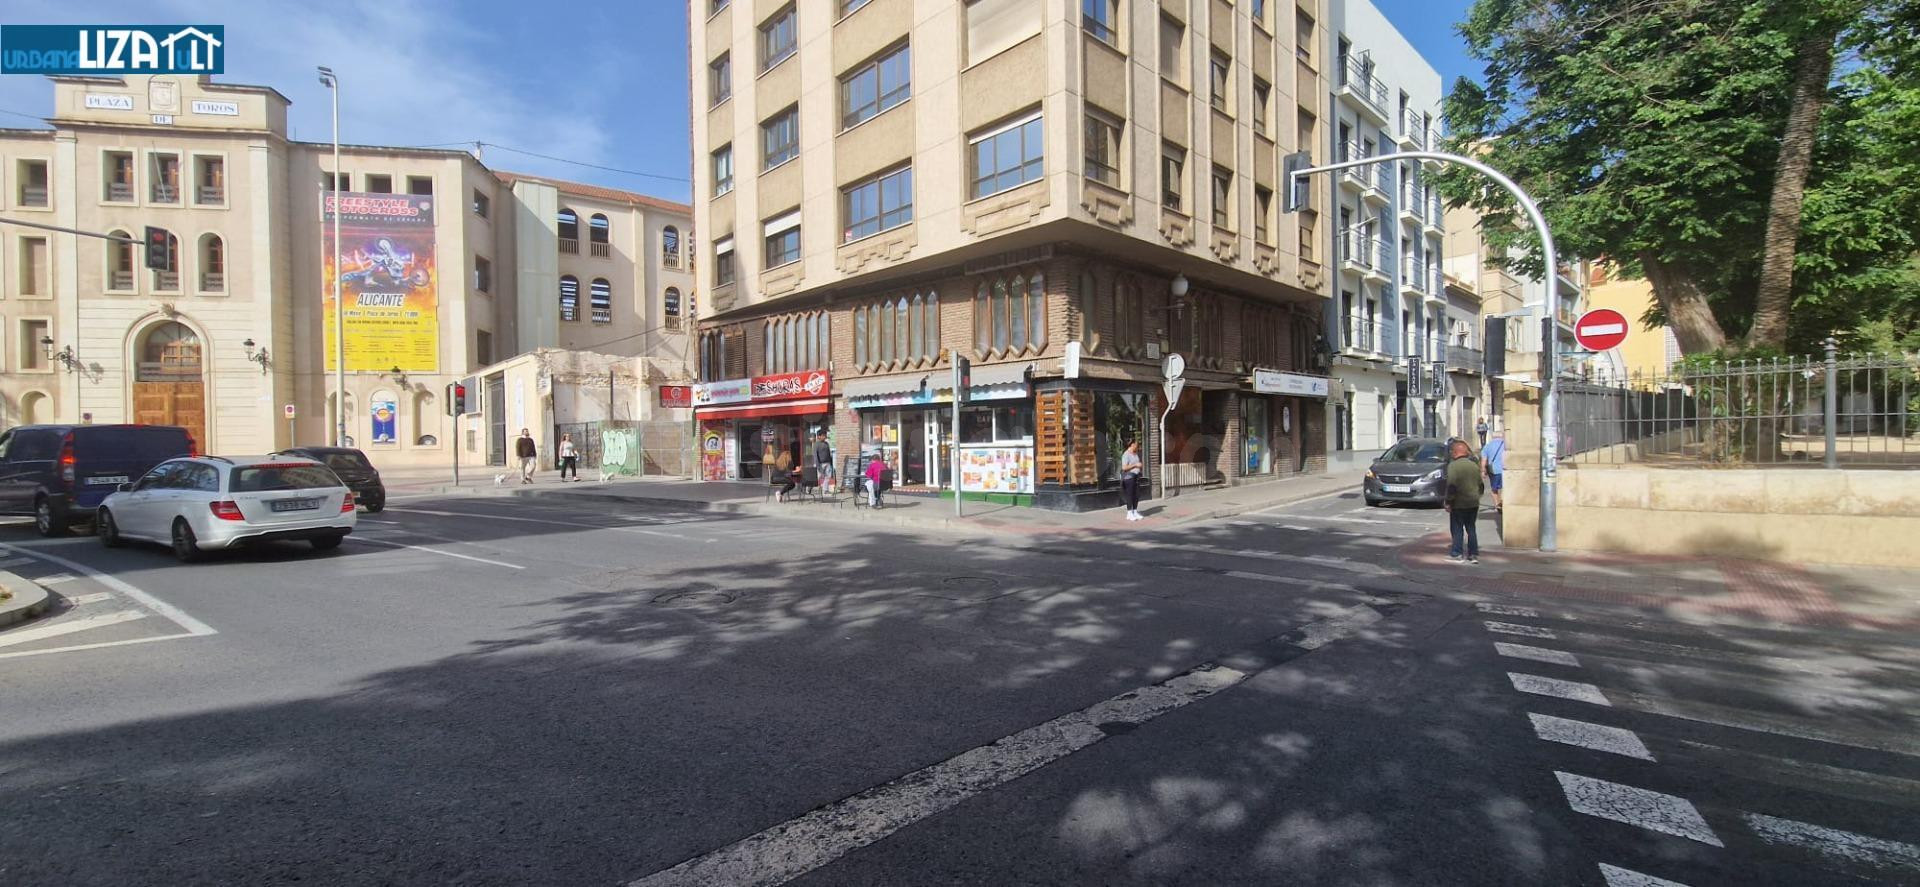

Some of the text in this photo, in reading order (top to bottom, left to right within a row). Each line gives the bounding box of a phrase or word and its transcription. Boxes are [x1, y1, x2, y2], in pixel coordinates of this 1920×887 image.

[89, 97, 130, 108] PLAZA
[196, 102, 235, 113] TOROS
[154, 115, 170, 124] DE
[357, 293, 404, 307] ALICANTE
